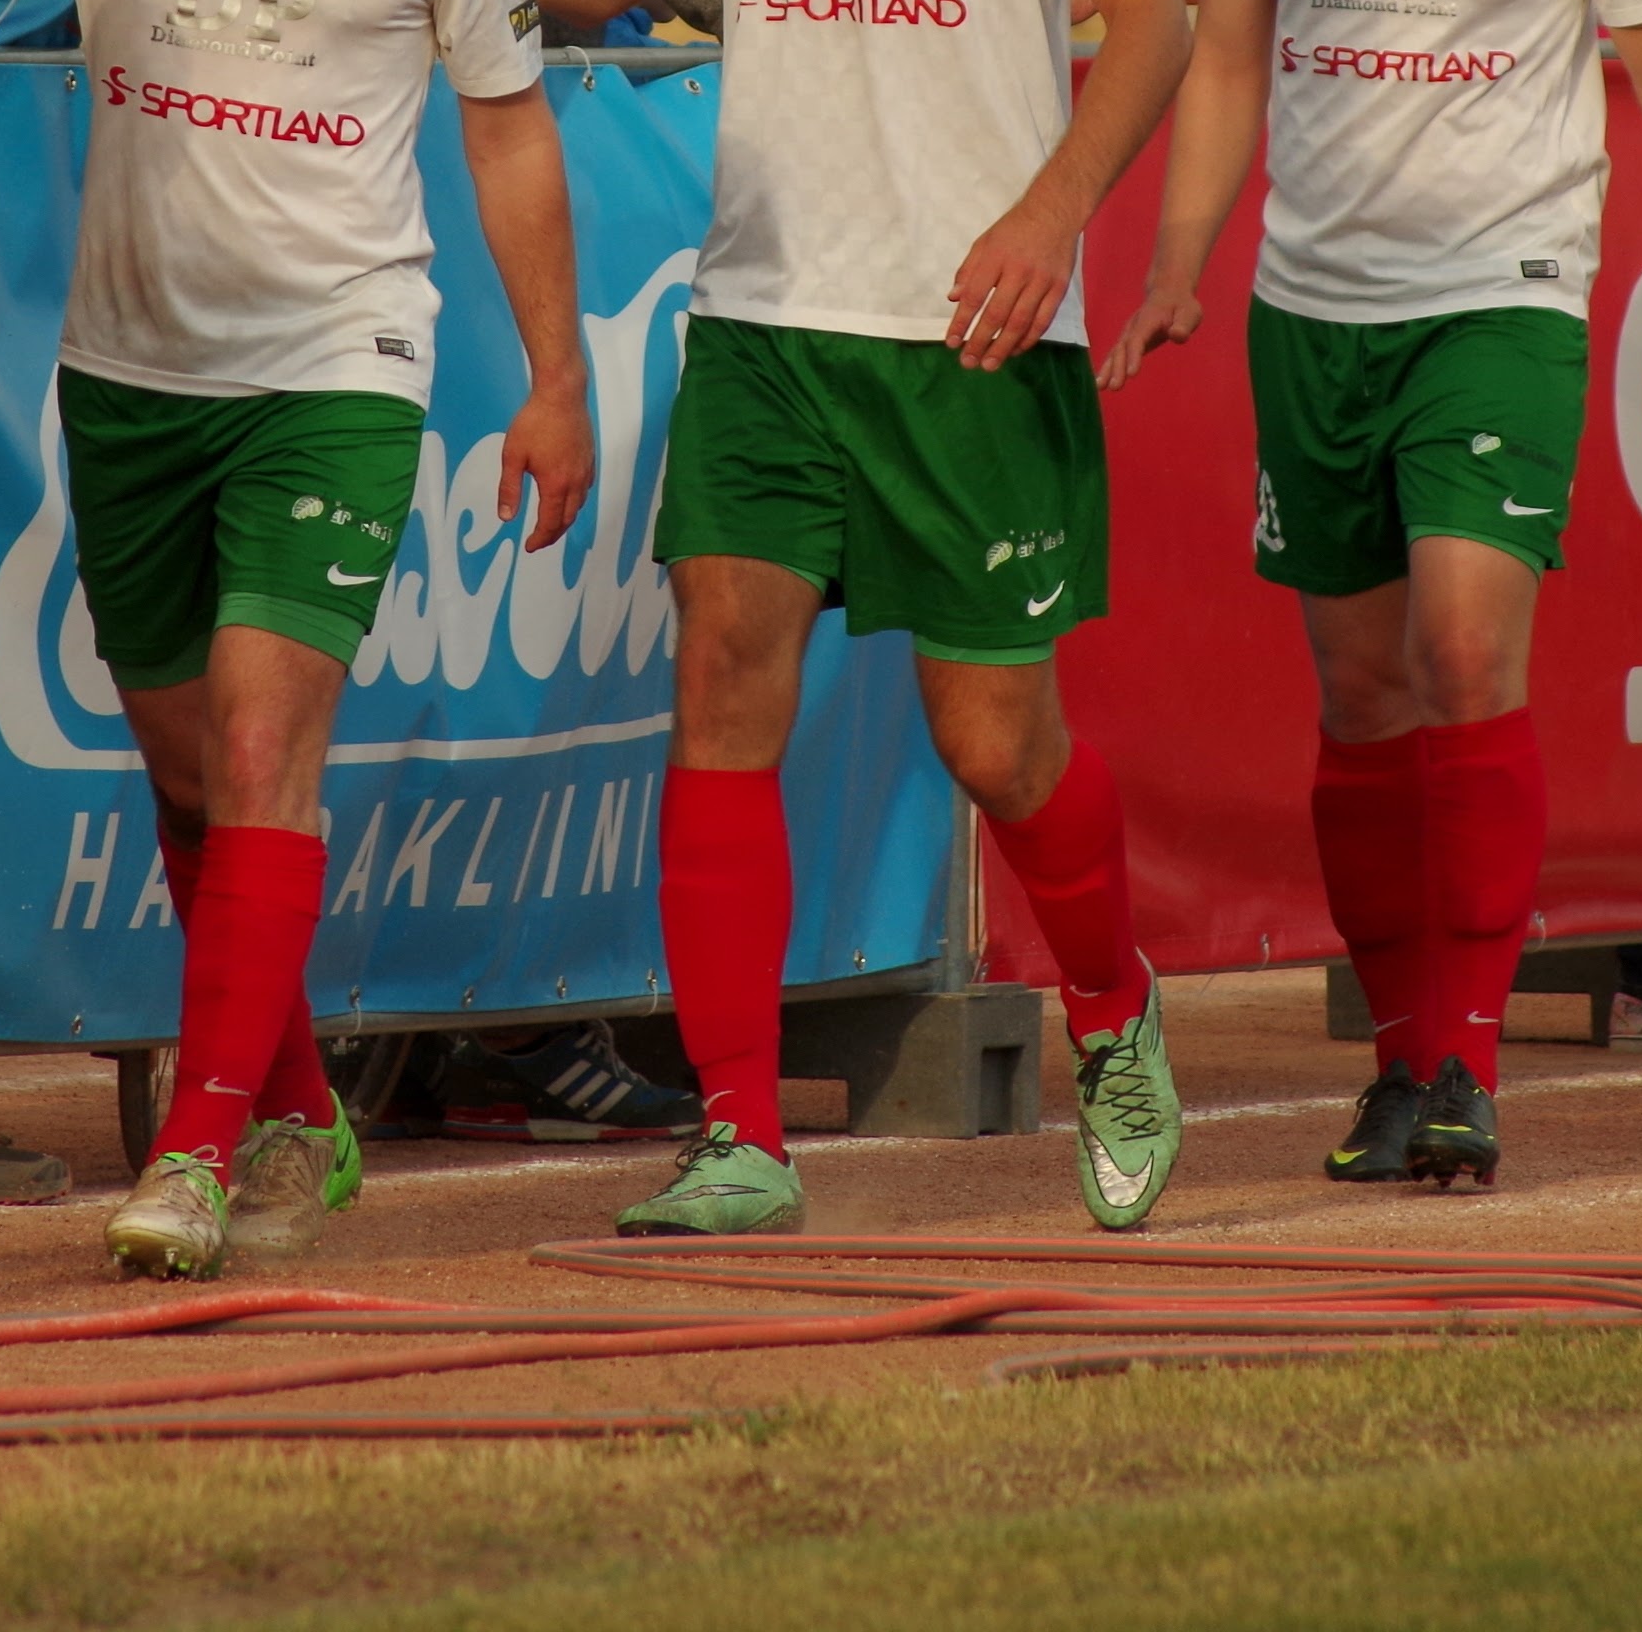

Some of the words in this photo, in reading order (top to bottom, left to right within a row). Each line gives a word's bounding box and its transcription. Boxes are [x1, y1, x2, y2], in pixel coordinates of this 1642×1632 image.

[150, 25, 251, 57] Diamond
[1314, 45, 1516, 82] SPORTLAND
[141, 82, 365, 146] SPORTLAND
